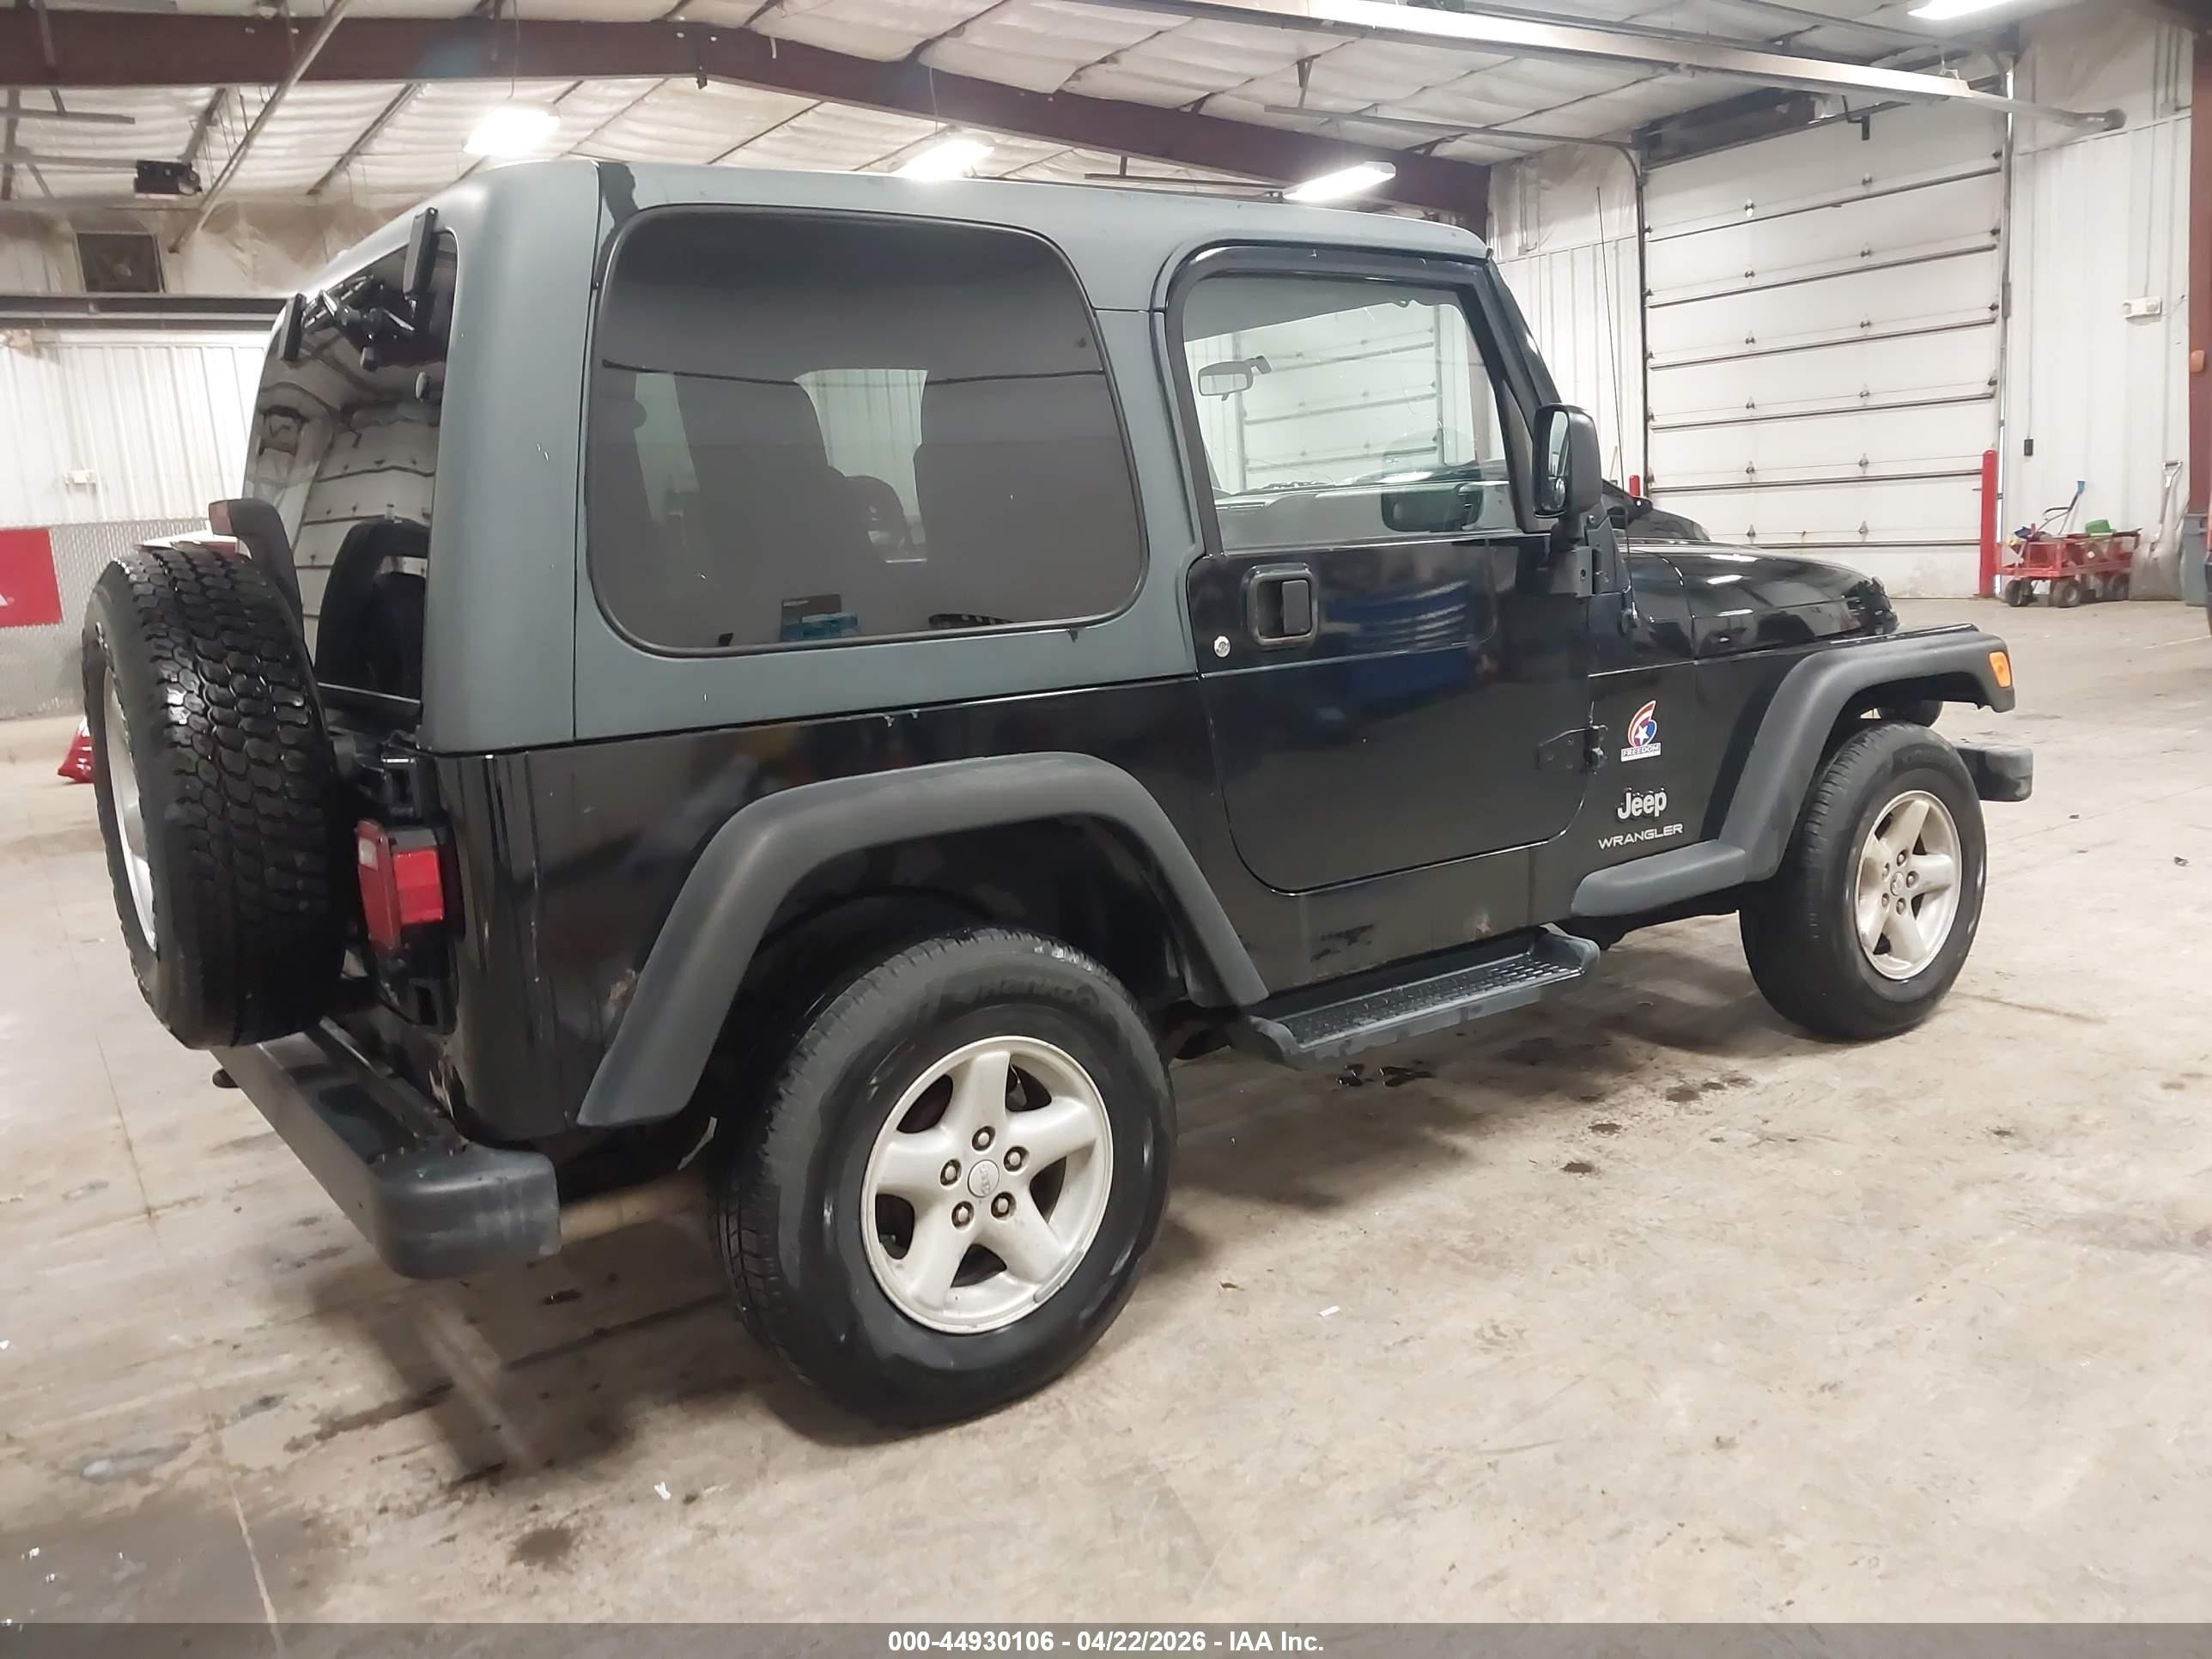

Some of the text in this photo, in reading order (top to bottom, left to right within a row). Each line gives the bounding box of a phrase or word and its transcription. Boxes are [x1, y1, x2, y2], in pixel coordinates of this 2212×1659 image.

[1622, 744, 1659, 757] FREEDOM
[1617, 789, 1667, 819] Jeep
[1598, 823, 1684, 850] WRANGLER
